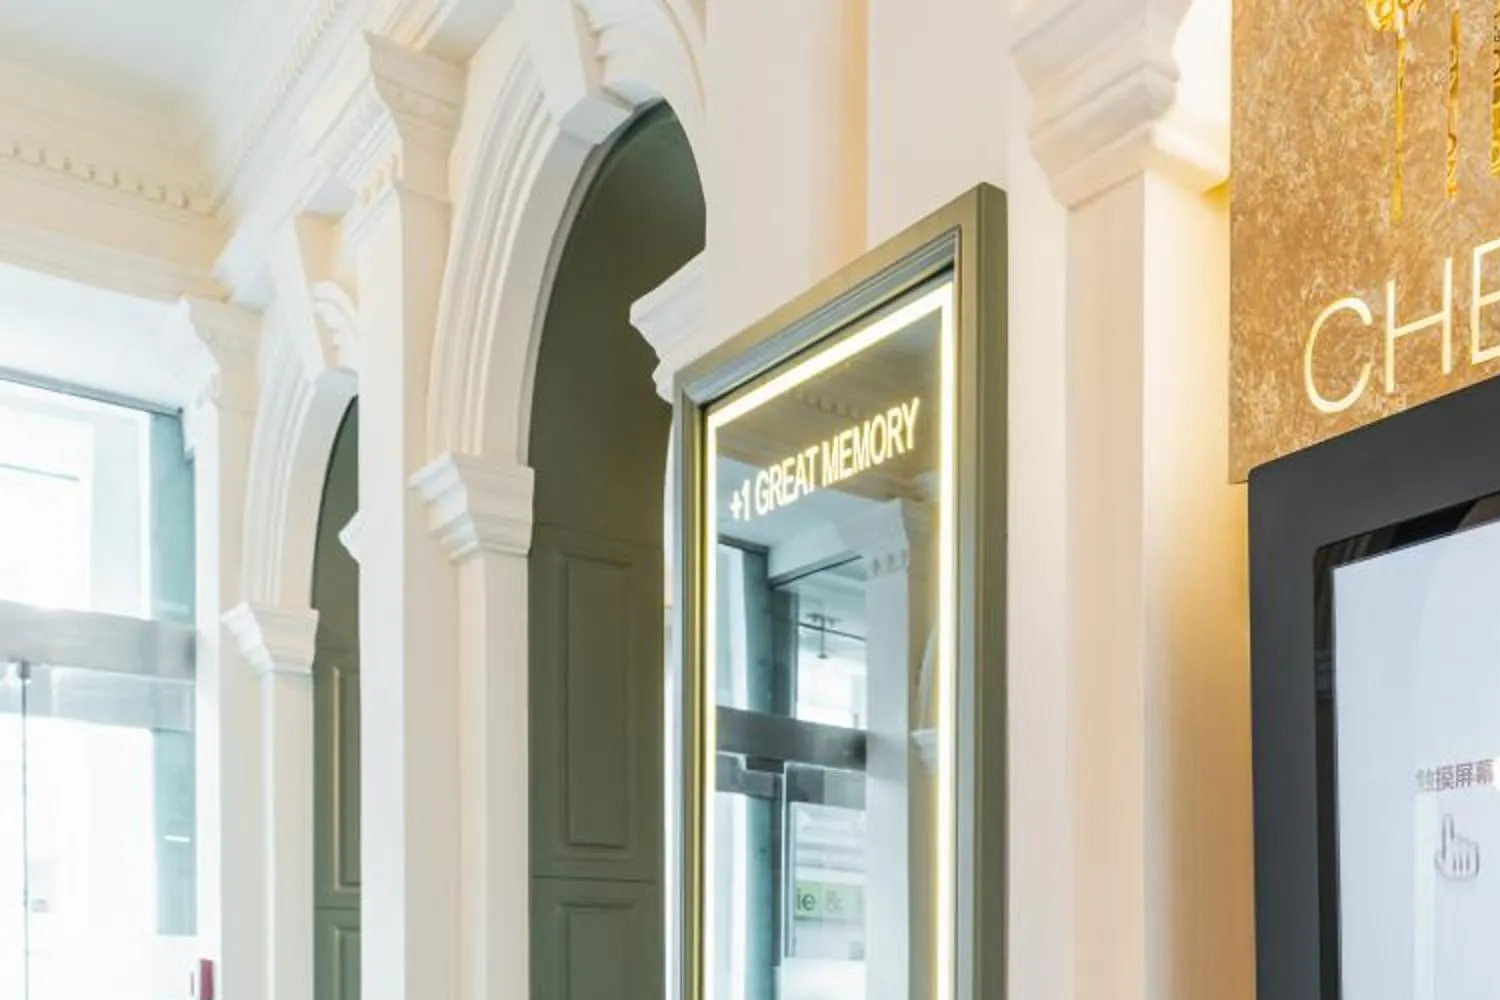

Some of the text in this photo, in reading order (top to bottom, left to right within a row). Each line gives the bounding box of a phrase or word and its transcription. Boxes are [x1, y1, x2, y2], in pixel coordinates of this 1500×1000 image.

[729, 397, 920, 521] +1 GREAT MEMORY
